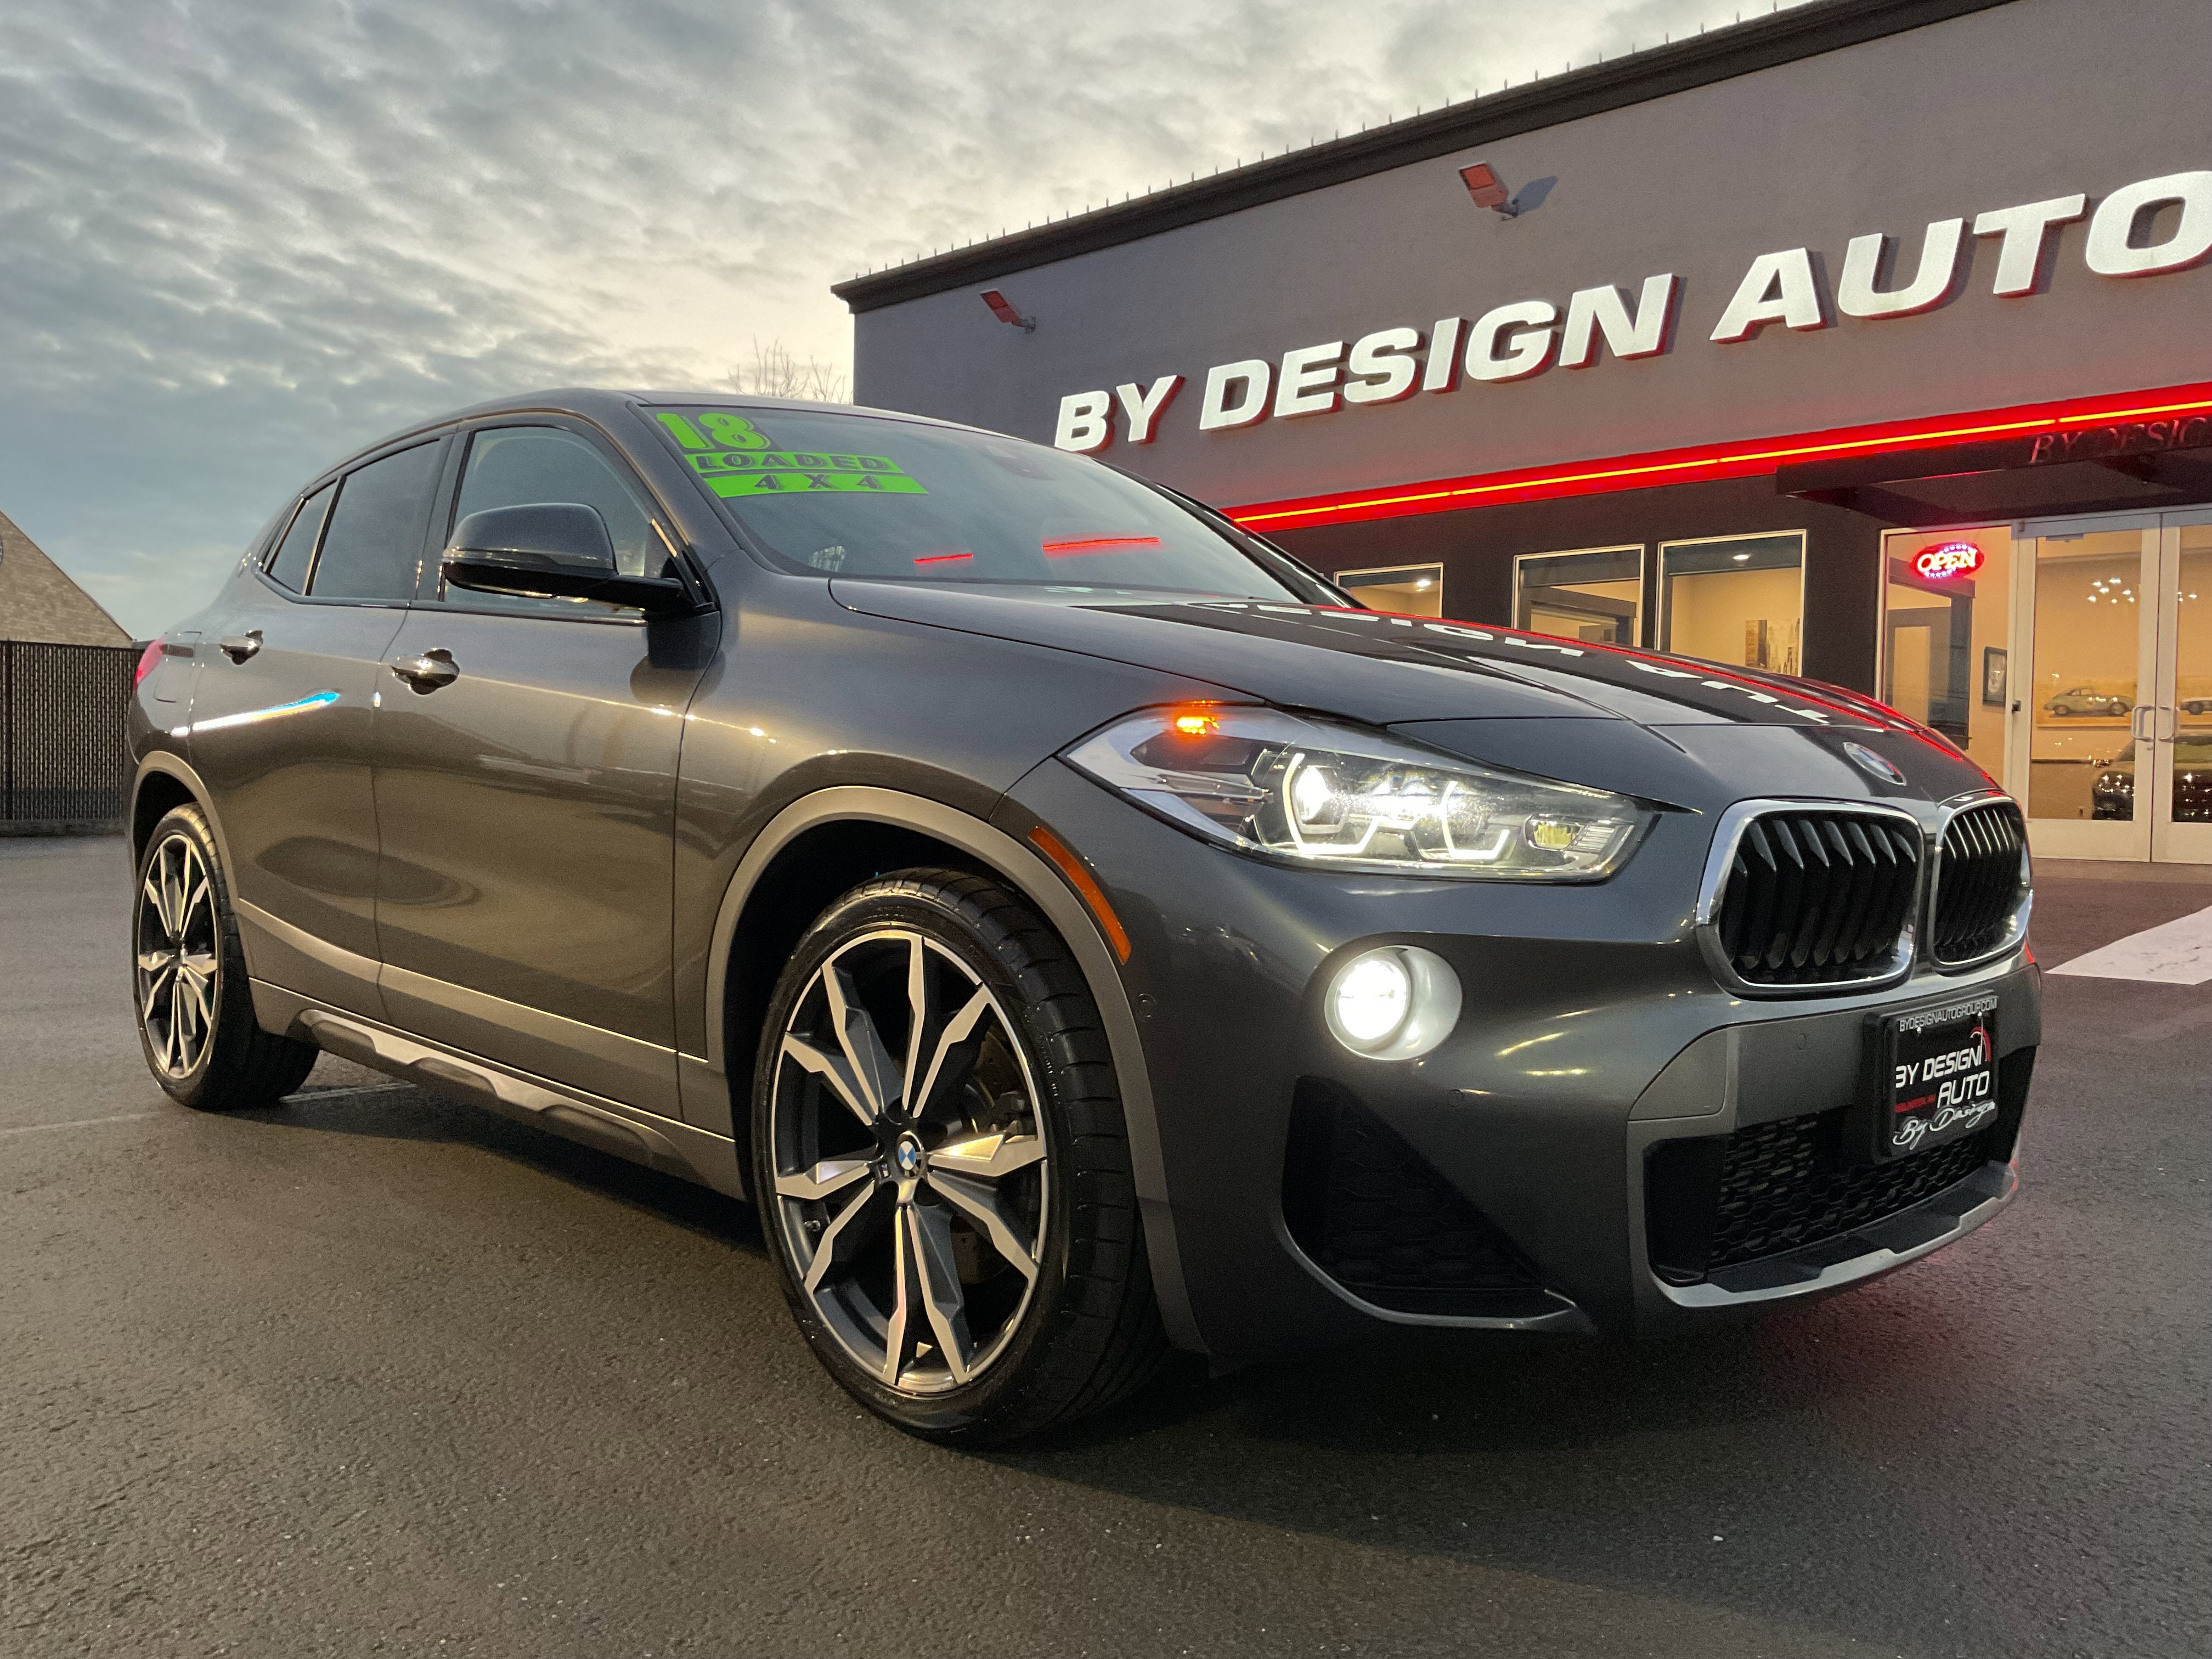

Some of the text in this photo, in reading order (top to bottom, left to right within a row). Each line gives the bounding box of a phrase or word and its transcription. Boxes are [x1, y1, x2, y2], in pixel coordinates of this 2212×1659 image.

[1054, 170, 2212, 451] BY DESIGN AUTO
[657, 413, 770, 449] 18
[696, 453, 888, 470] LOADED
[1917, 549, 1977, 572] OPEN
[1899, 998, 1997, 1032] BYDESIGNAUTOGROUPCOM
[1896, 1046, 1982, 1088] BY DESIGN
[1937, 1071, 1989, 1108] AUTO
[1893, 1119, 1928, 1150] By
